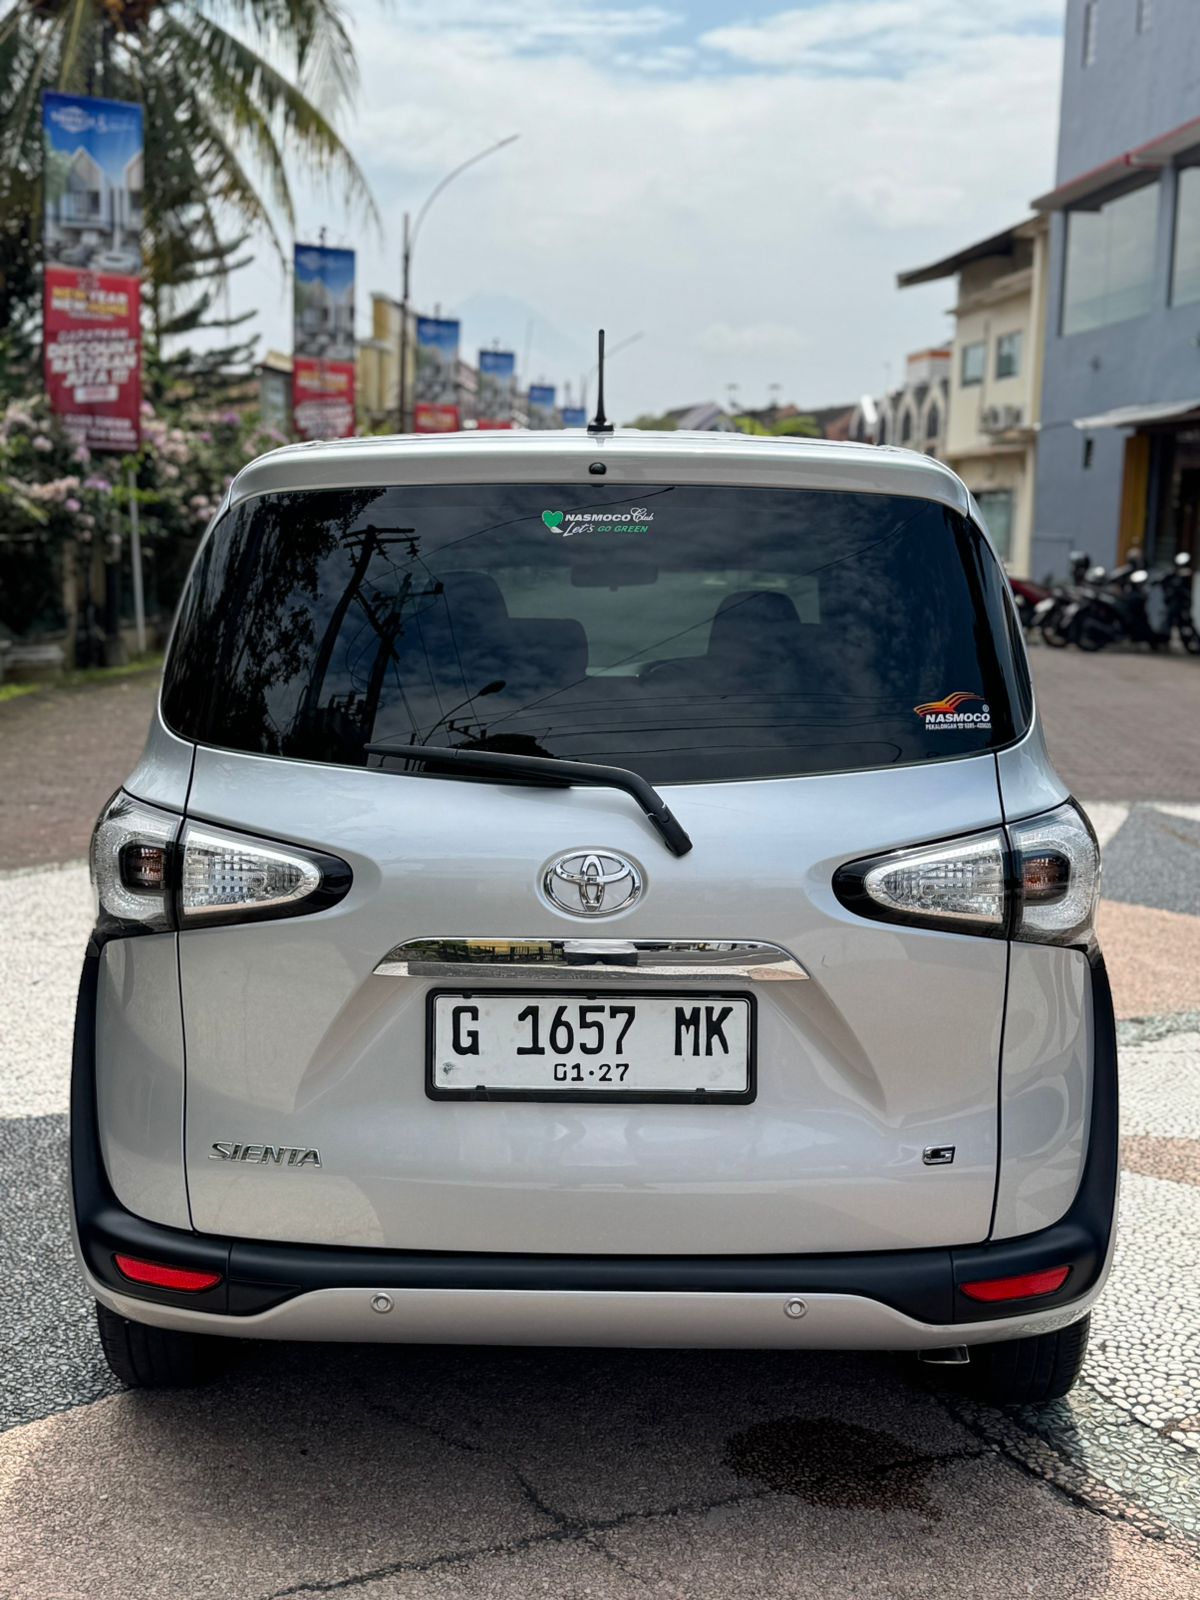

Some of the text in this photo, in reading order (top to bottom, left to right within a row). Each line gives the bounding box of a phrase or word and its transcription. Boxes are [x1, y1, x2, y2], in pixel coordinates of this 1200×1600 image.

[565, 507, 655, 522] NASMOCO Club
[563, 522, 649, 537] Let's GO GREEN
[925, 713, 991, 723] NASMOCO
[452, 1005, 734, 1057] G 1657 MK
[208, 1140, 323, 1168] SIENTA
